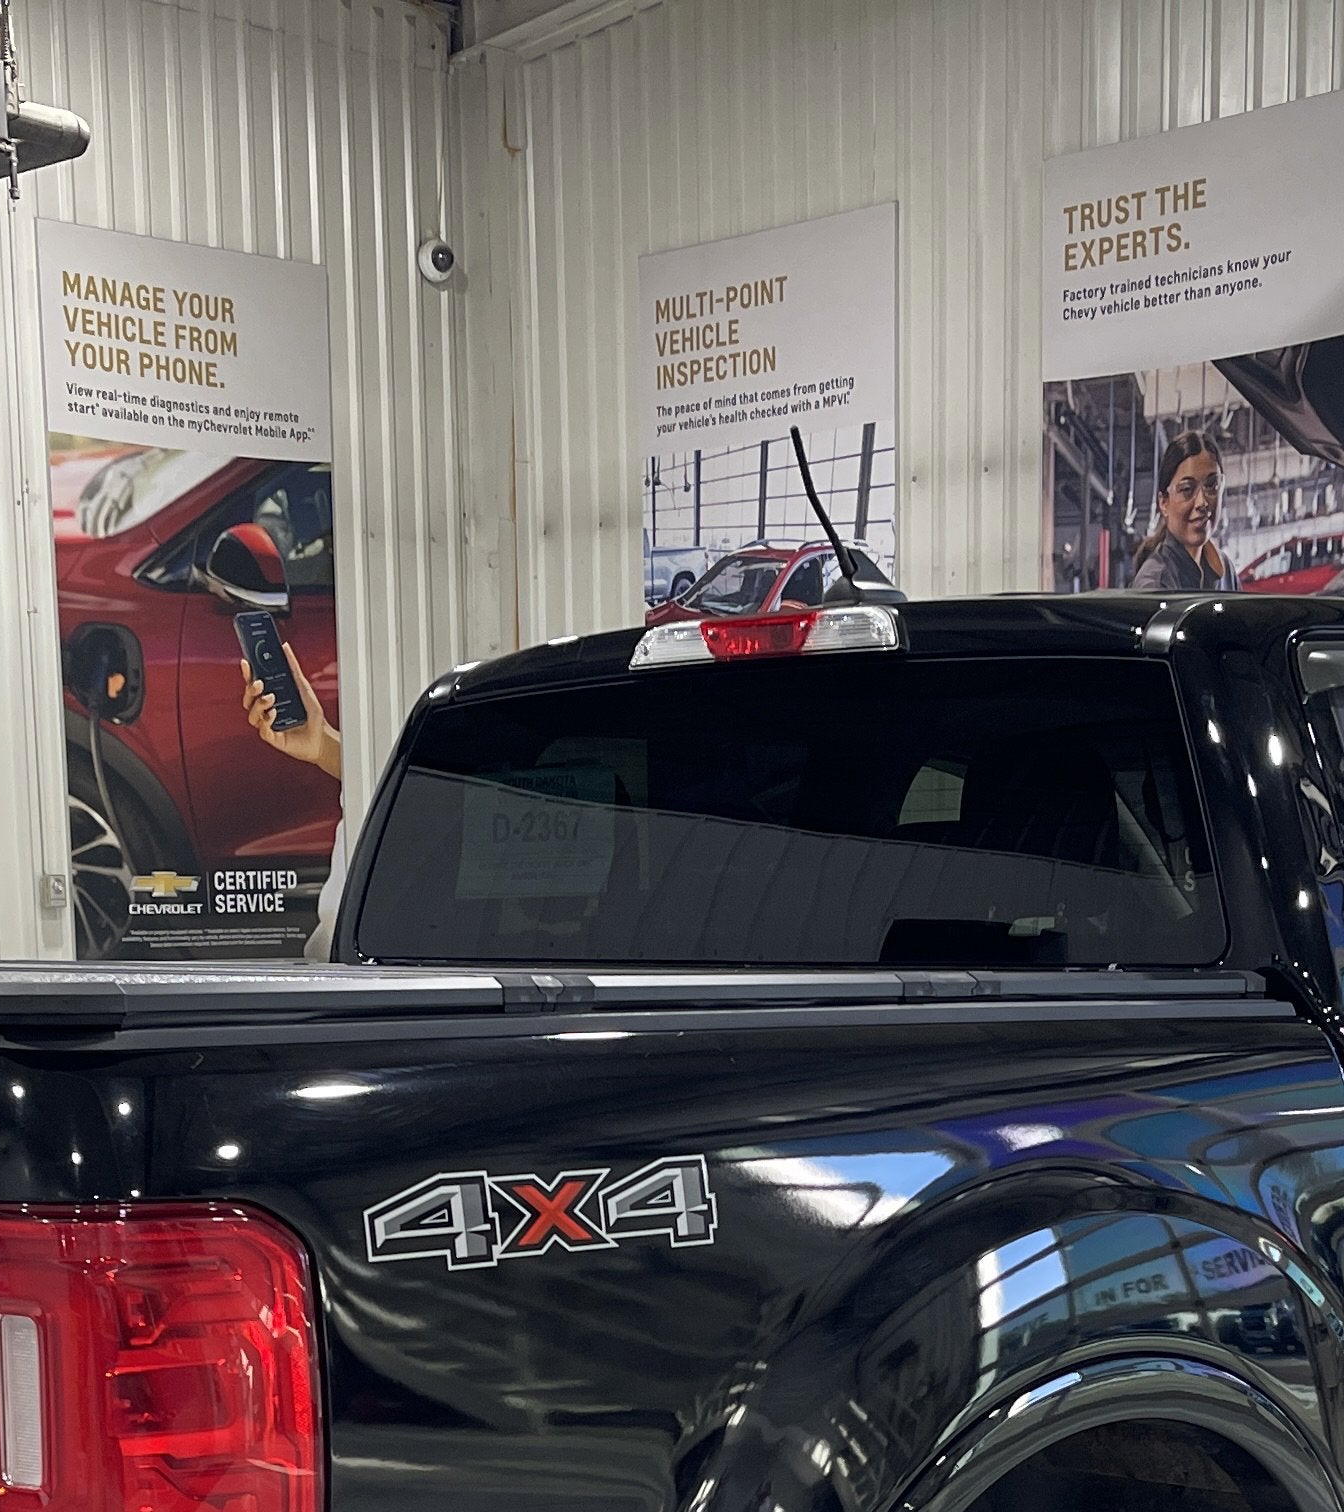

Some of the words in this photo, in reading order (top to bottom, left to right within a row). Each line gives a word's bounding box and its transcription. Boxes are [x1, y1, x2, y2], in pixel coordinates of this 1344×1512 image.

[1063, 190, 1147, 235] TRUST
[1154, 177, 1207, 217] THE
[1064, 222, 1191, 272] EXPERTS.
[61, 270, 166, 314] MANAGE
[172, 288, 236, 324] YOUR
[1063, 286, 1106, 302] Factory
[1109, 275, 1152, 296] trained
[1155, 262, 1224, 288] technicians
[1226, 257, 1260, 274] know
[1262, 250, 1292, 270] your
[1063, 306, 1097, 320] Chevy
[1100, 296, 1140, 315] vehicle
[1143, 290, 1181, 309] better
[1184, 284, 1211, 302] than
[1214, 276, 1264, 297] anyone.
[656, 275, 788, 325] MULTI-POINT
[63, 304, 167, 348] VEHICLE
[175, 323, 238, 357] FROM
[655, 319, 740, 357] VEHICLE
[64, 338, 131, 376] YOUR
[139, 352, 226, 388] PHONE.
[657, 346, 777, 390] INSPECTION
[66, 381, 94, 397] View
[96, 388, 147, 407] real-time
[150, 395, 211, 415] diagnostics
[212, 404, 232, 417] and
[234, 407, 261, 422] enjoy
[263, 411, 300, 423] remote
[656, 406, 673, 418] The
[674, 402, 701, 418] peace
[703, 397, 712, 411] of
[714, 394, 737, 409] mind
[739, 391, 758, 405] that
[760, 387, 791, 402] comes
[794, 382, 817, 396] from
[819, 376, 855, 394] getting
[656, 422, 677, 438] your
[678, 414, 717, 431] vehicle's
[719, 410, 748, 425] health
[750, 403, 789, 421] checked
[791, 398, 812, 413] with
[814, 401, 821, 410] a
[102, 408, 149, 424] available
[152, 415, 165, 426] on
[168, 414, 185, 428] the
[187, 419, 253, 436] myChevrolet
[255, 425, 287, 439] Mobile
[214, 870, 298, 891] CERTIFIED
[128, 902, 203, 916] CHEVROLET
[214, 894, 285, 914] SERVICE
